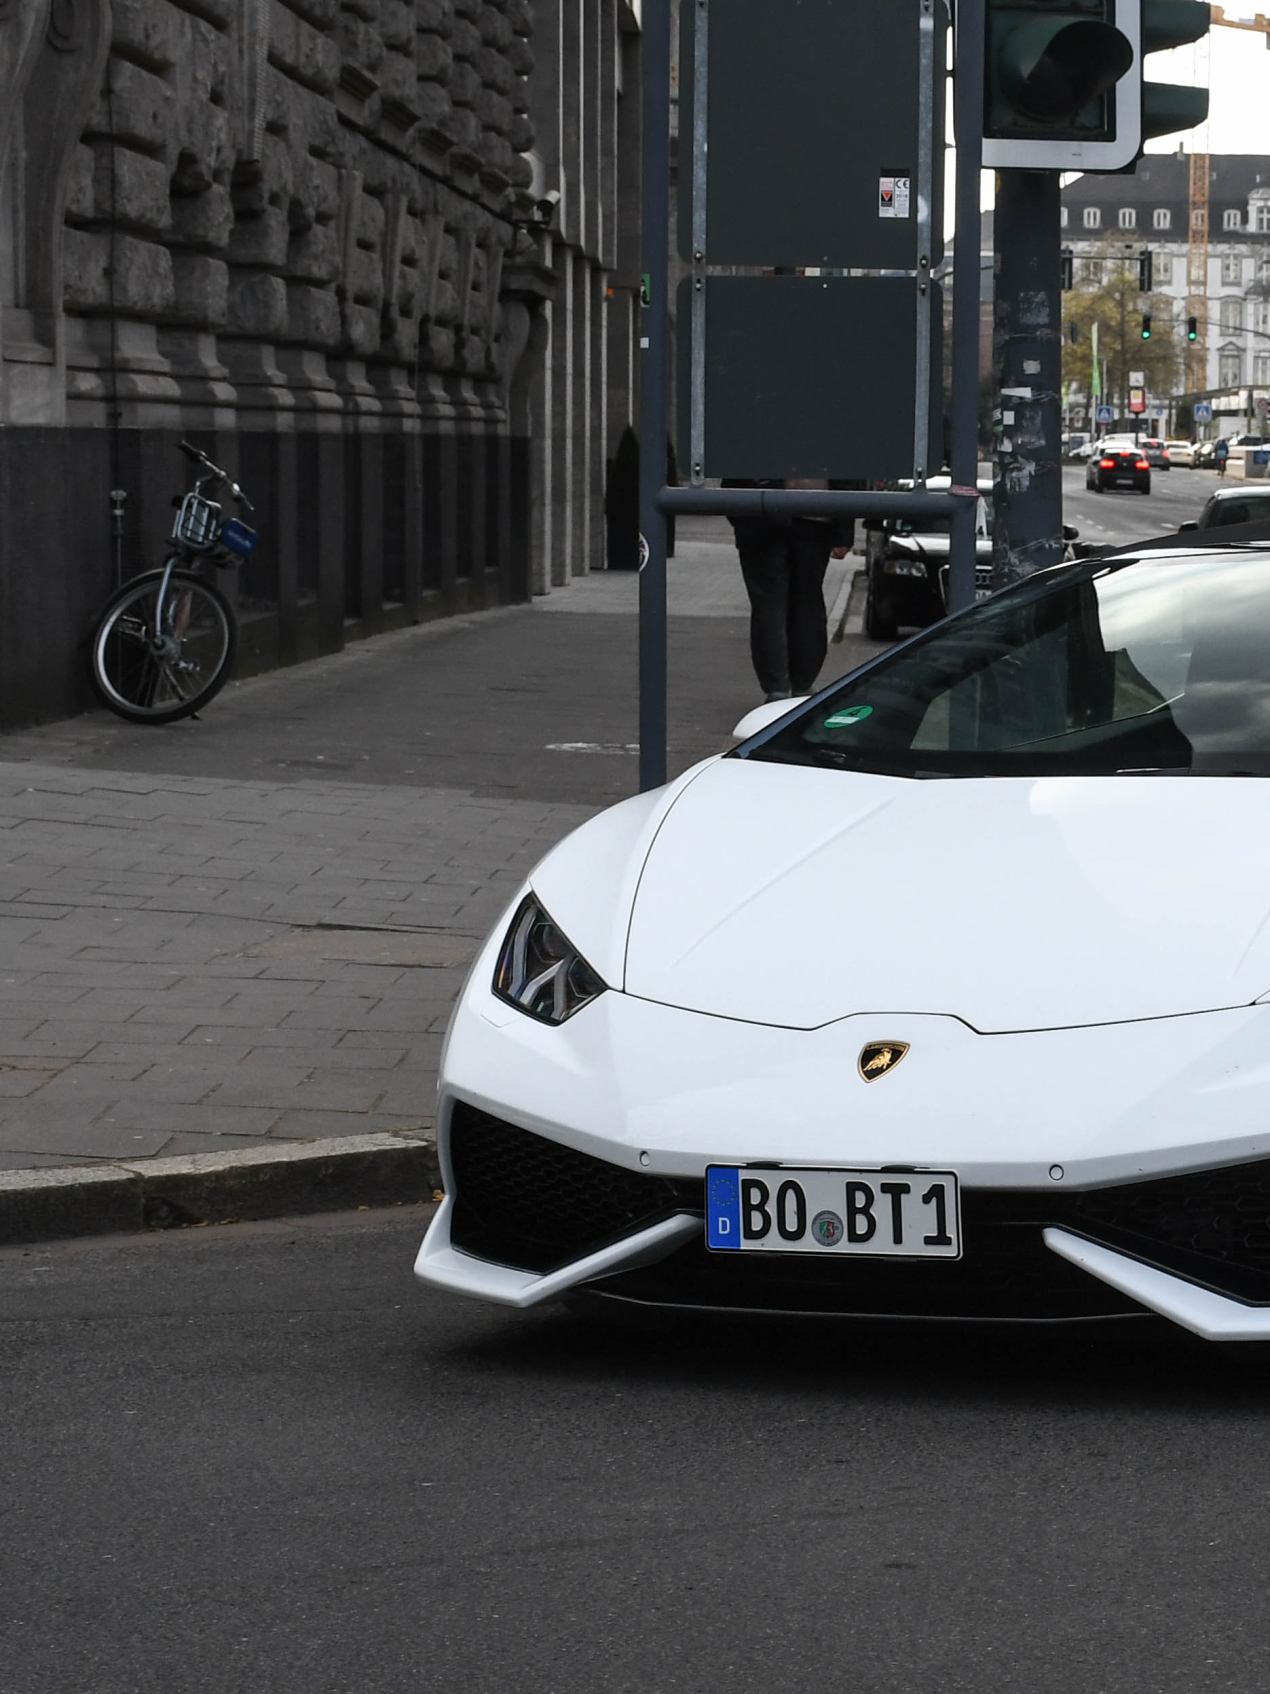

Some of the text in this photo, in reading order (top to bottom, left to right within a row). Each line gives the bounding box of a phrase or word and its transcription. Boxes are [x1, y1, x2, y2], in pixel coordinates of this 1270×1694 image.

[896, 179, 909, 189] CE
[741, 1178, 807, 1242] BO
[718, 1217, 730, 1235] D
